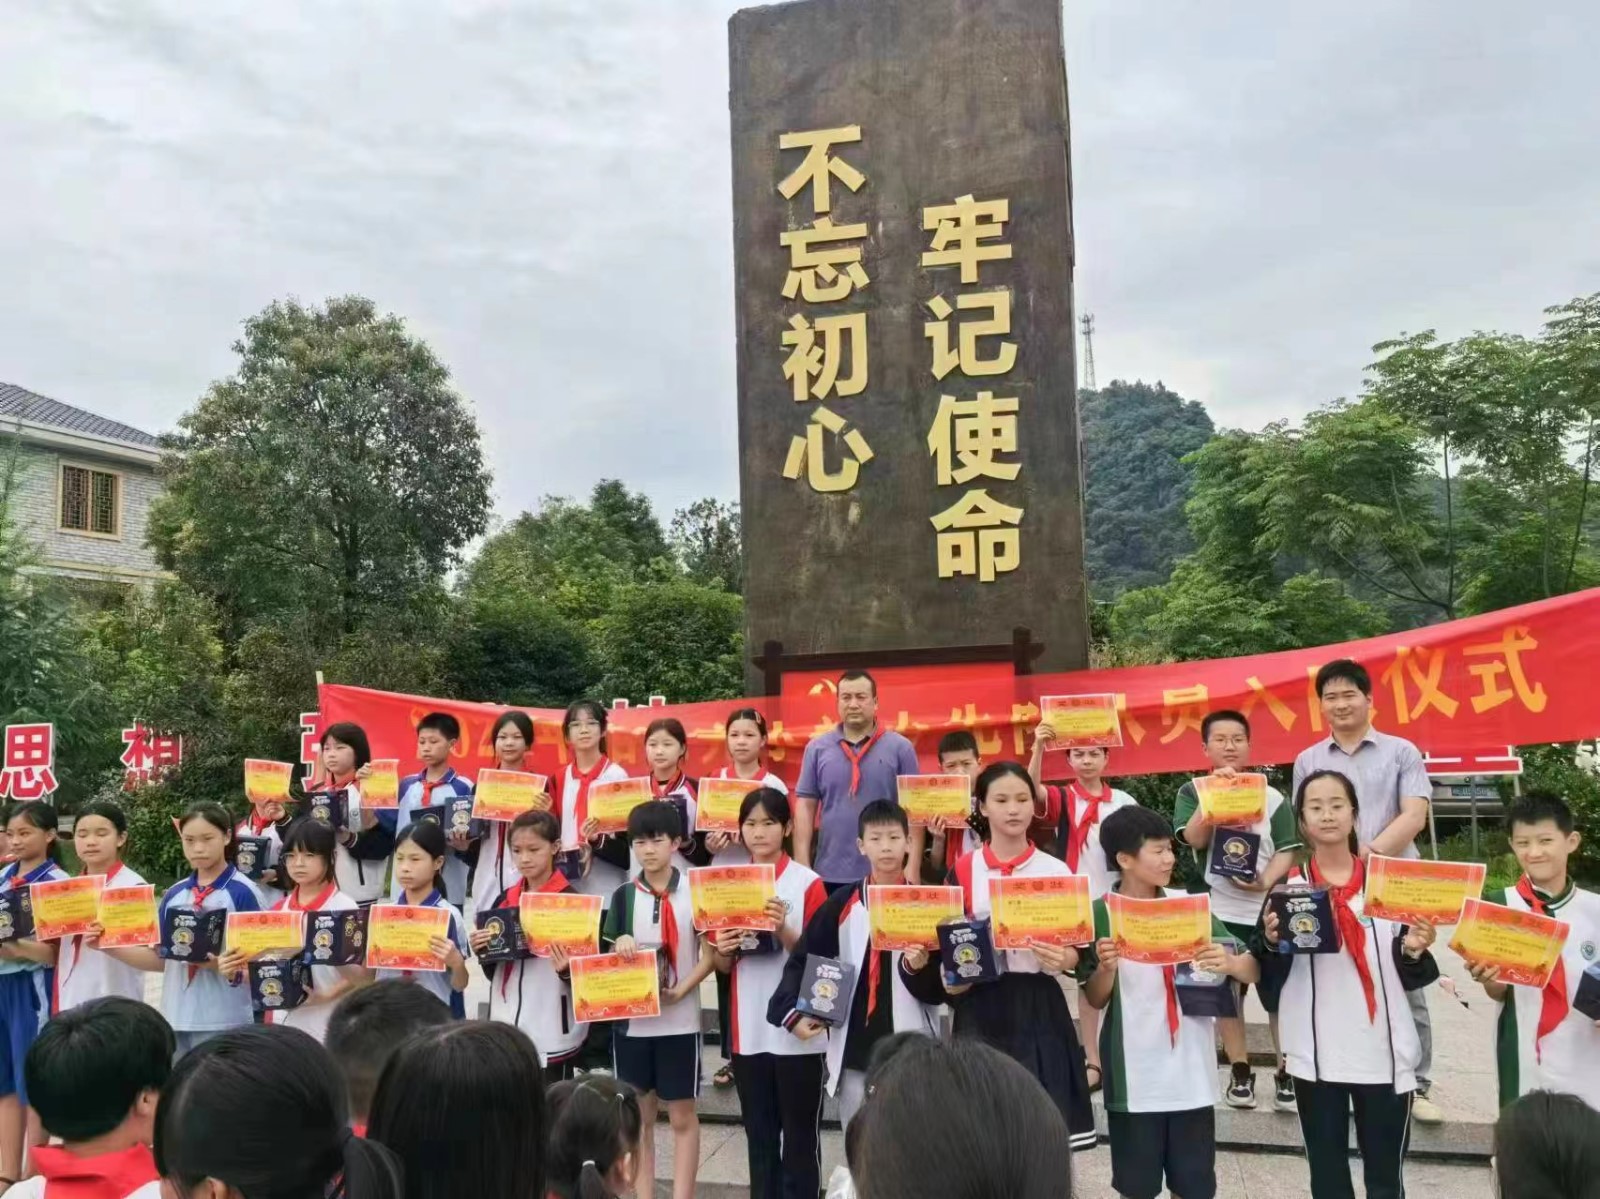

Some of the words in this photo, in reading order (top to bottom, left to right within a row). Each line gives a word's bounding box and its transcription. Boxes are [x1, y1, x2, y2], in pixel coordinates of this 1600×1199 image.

[778, 125, 874, 492] 不忘初心
[922, 194, 1024, 582] 牢记使命
